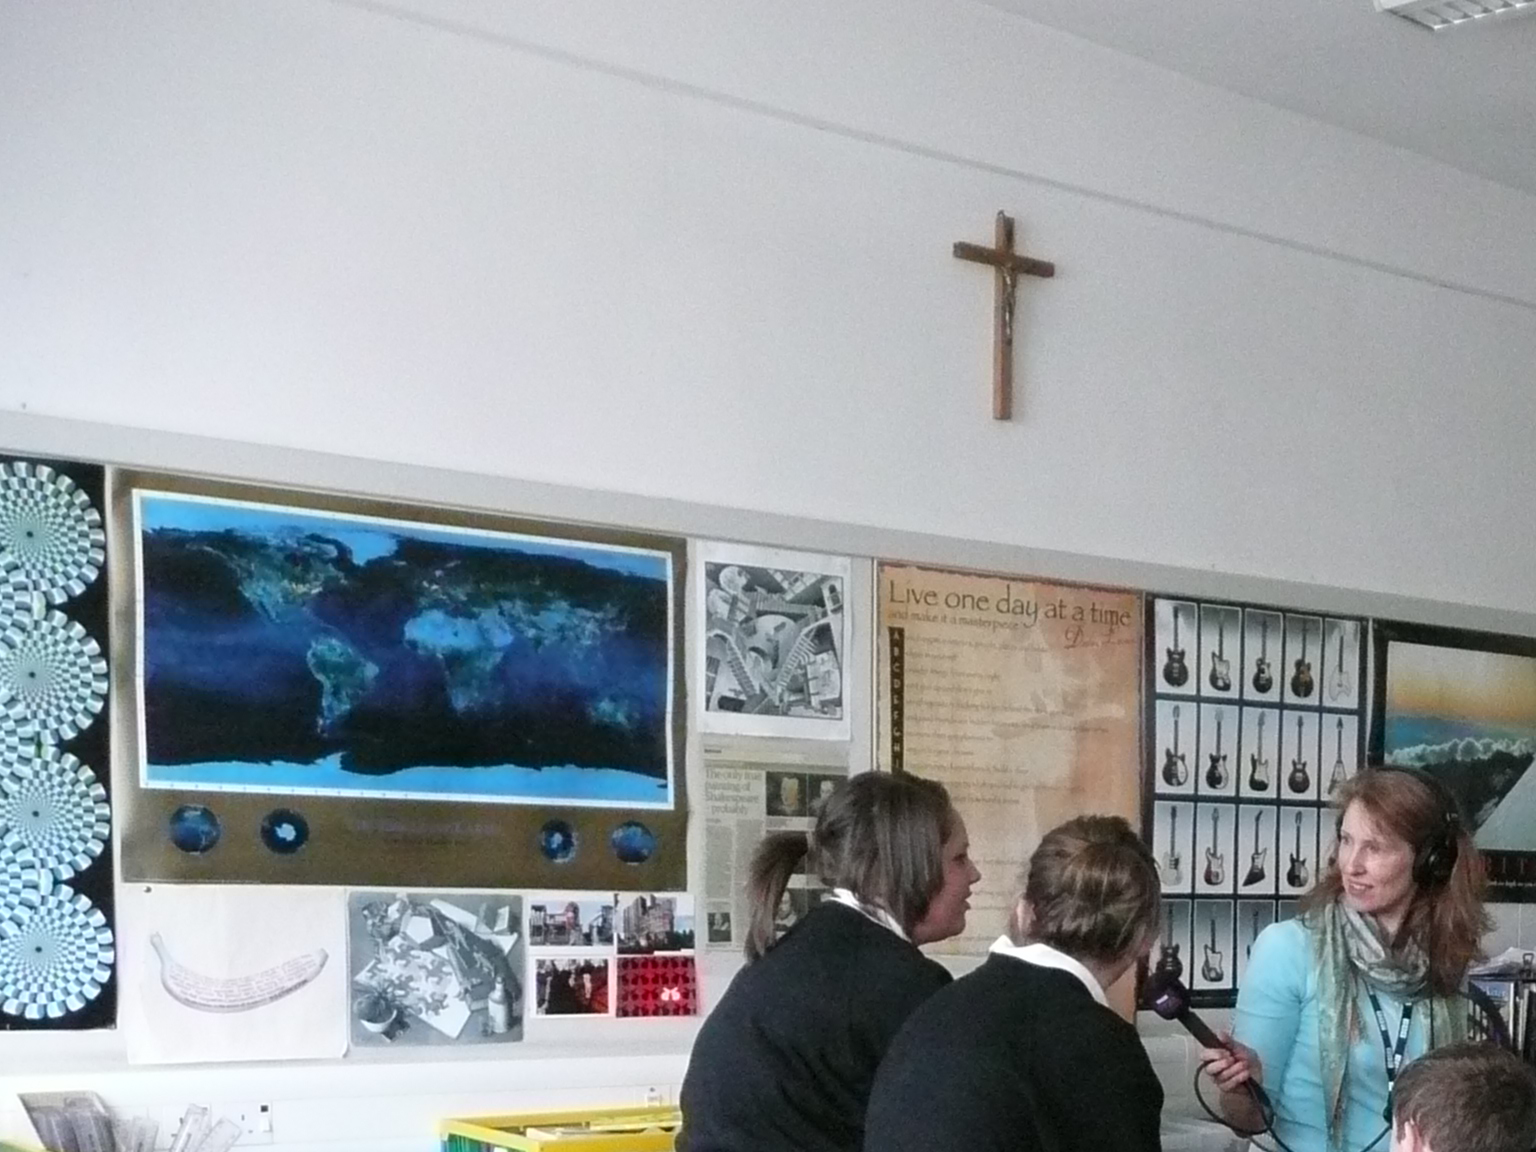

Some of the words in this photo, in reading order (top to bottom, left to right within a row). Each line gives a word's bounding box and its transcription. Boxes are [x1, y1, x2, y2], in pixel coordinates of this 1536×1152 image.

[890, 580, 938, 606] Live
[944, 592, 990, 611] one
[996, 583, 1038, 628] day
[1044, 599, 1067, 620] at
[1071, 605, 1084, 621] a
[1091, 602, 1131, 627] time
